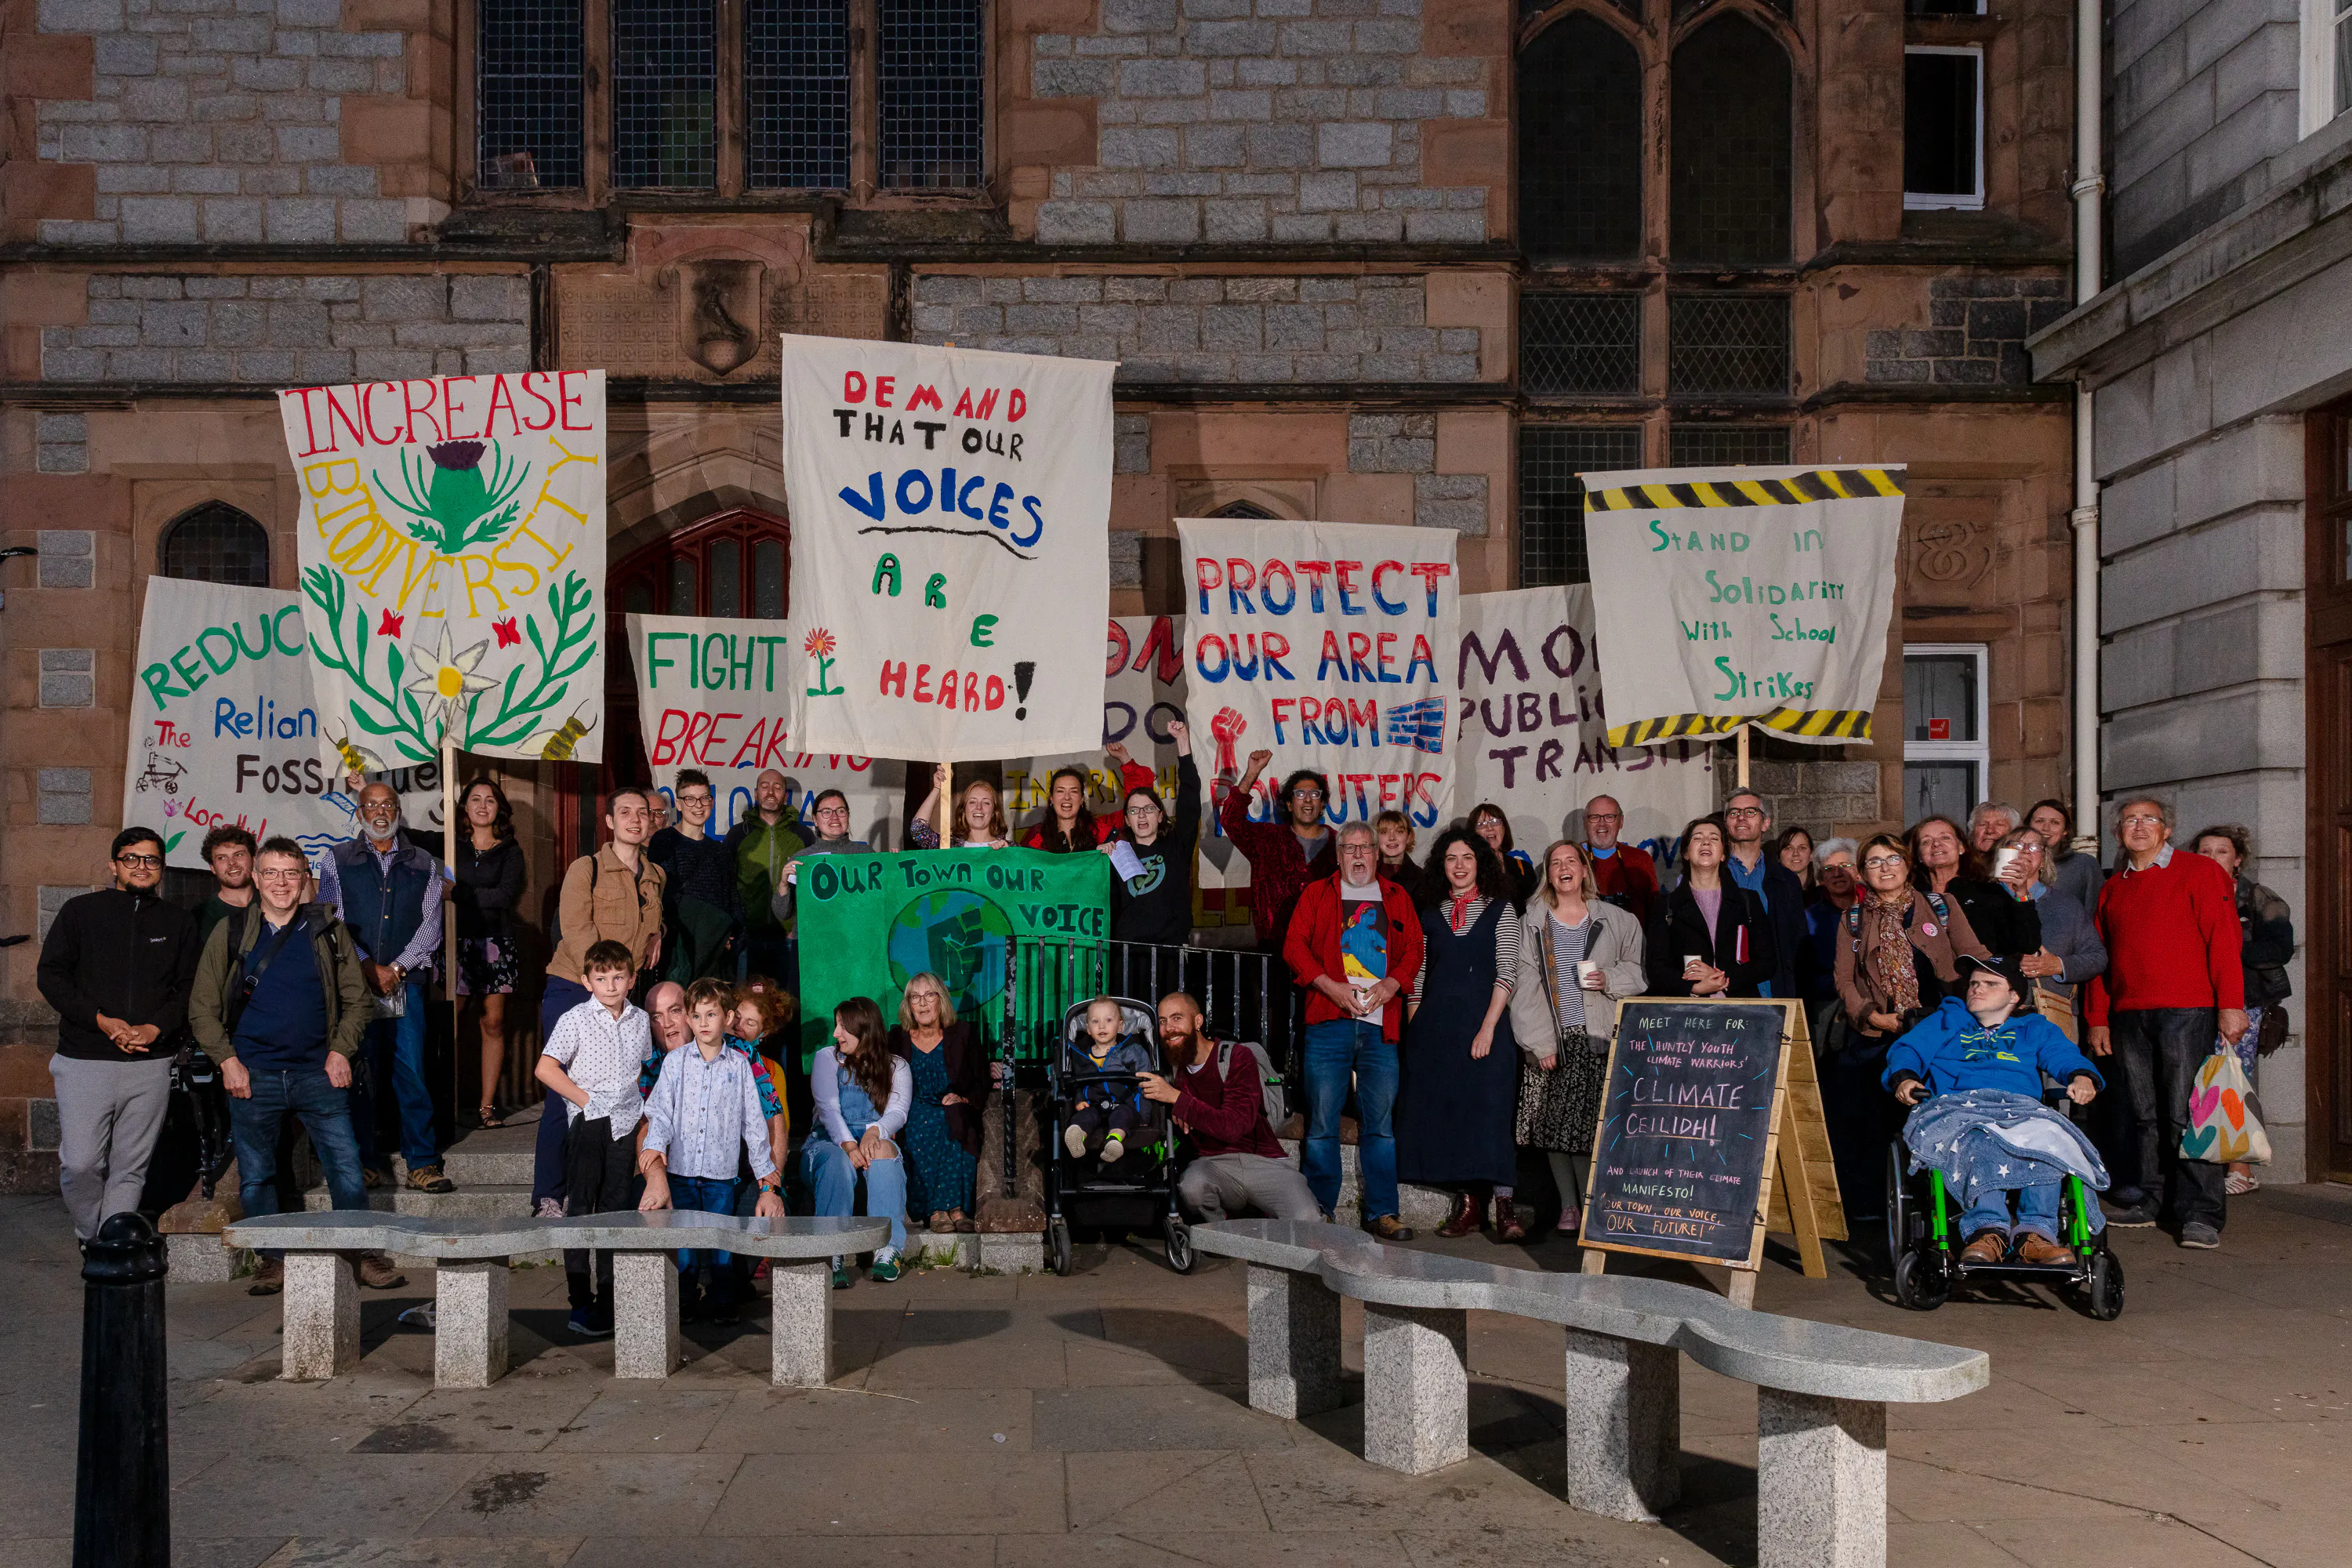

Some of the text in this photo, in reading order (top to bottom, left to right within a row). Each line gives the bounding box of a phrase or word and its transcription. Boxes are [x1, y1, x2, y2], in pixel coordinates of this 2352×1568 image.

[285, 369, 593, 458] INCREASE
[844, 370, 1027, 423] DEMAND
[833, 408, 1024, 463] THAT OUR
[838, 467, 1044, 548] VOICES
[1196, 557, 1450, 618] PROTECT
[1769, 612, 1836, 644] School
[140, 604, 304, 712] REDUC
[648, 632, 787, 692] FIGHT
[1196, 630, 1439, 684] OUR AREA
[154, 720, 192, 748] The
[214, 695, 317, 740] Relian
[1272, 696, 1381, 747] FROM
[1639, 1017, 1748, 1030] MEET HERE FOR:
[1629, 1040, 1646, 1051] THE
[1656, 1040, 1695, 1054] HUNTLY
[1647, 1055, 1682, 1068] CLIMATE
[1634, 1077, 1744, 1109] CLIMATE
[1626, 1112, 1716, 1146] CEILIDH!
[1607, 1165, 1624, 1175] AND
[1630, 1167, 1658, 1176] LAUNCH
[1679, 1169, 1704, 1179] THEIR
[1709, 1174, 1741, 1185] CLIMATE
[1622, 1182, 1694, 1201] MANIFESTO!
[1606, 1214, 1637, 1232] OUR
[1664, 1207, 1682, 1218] OUR
